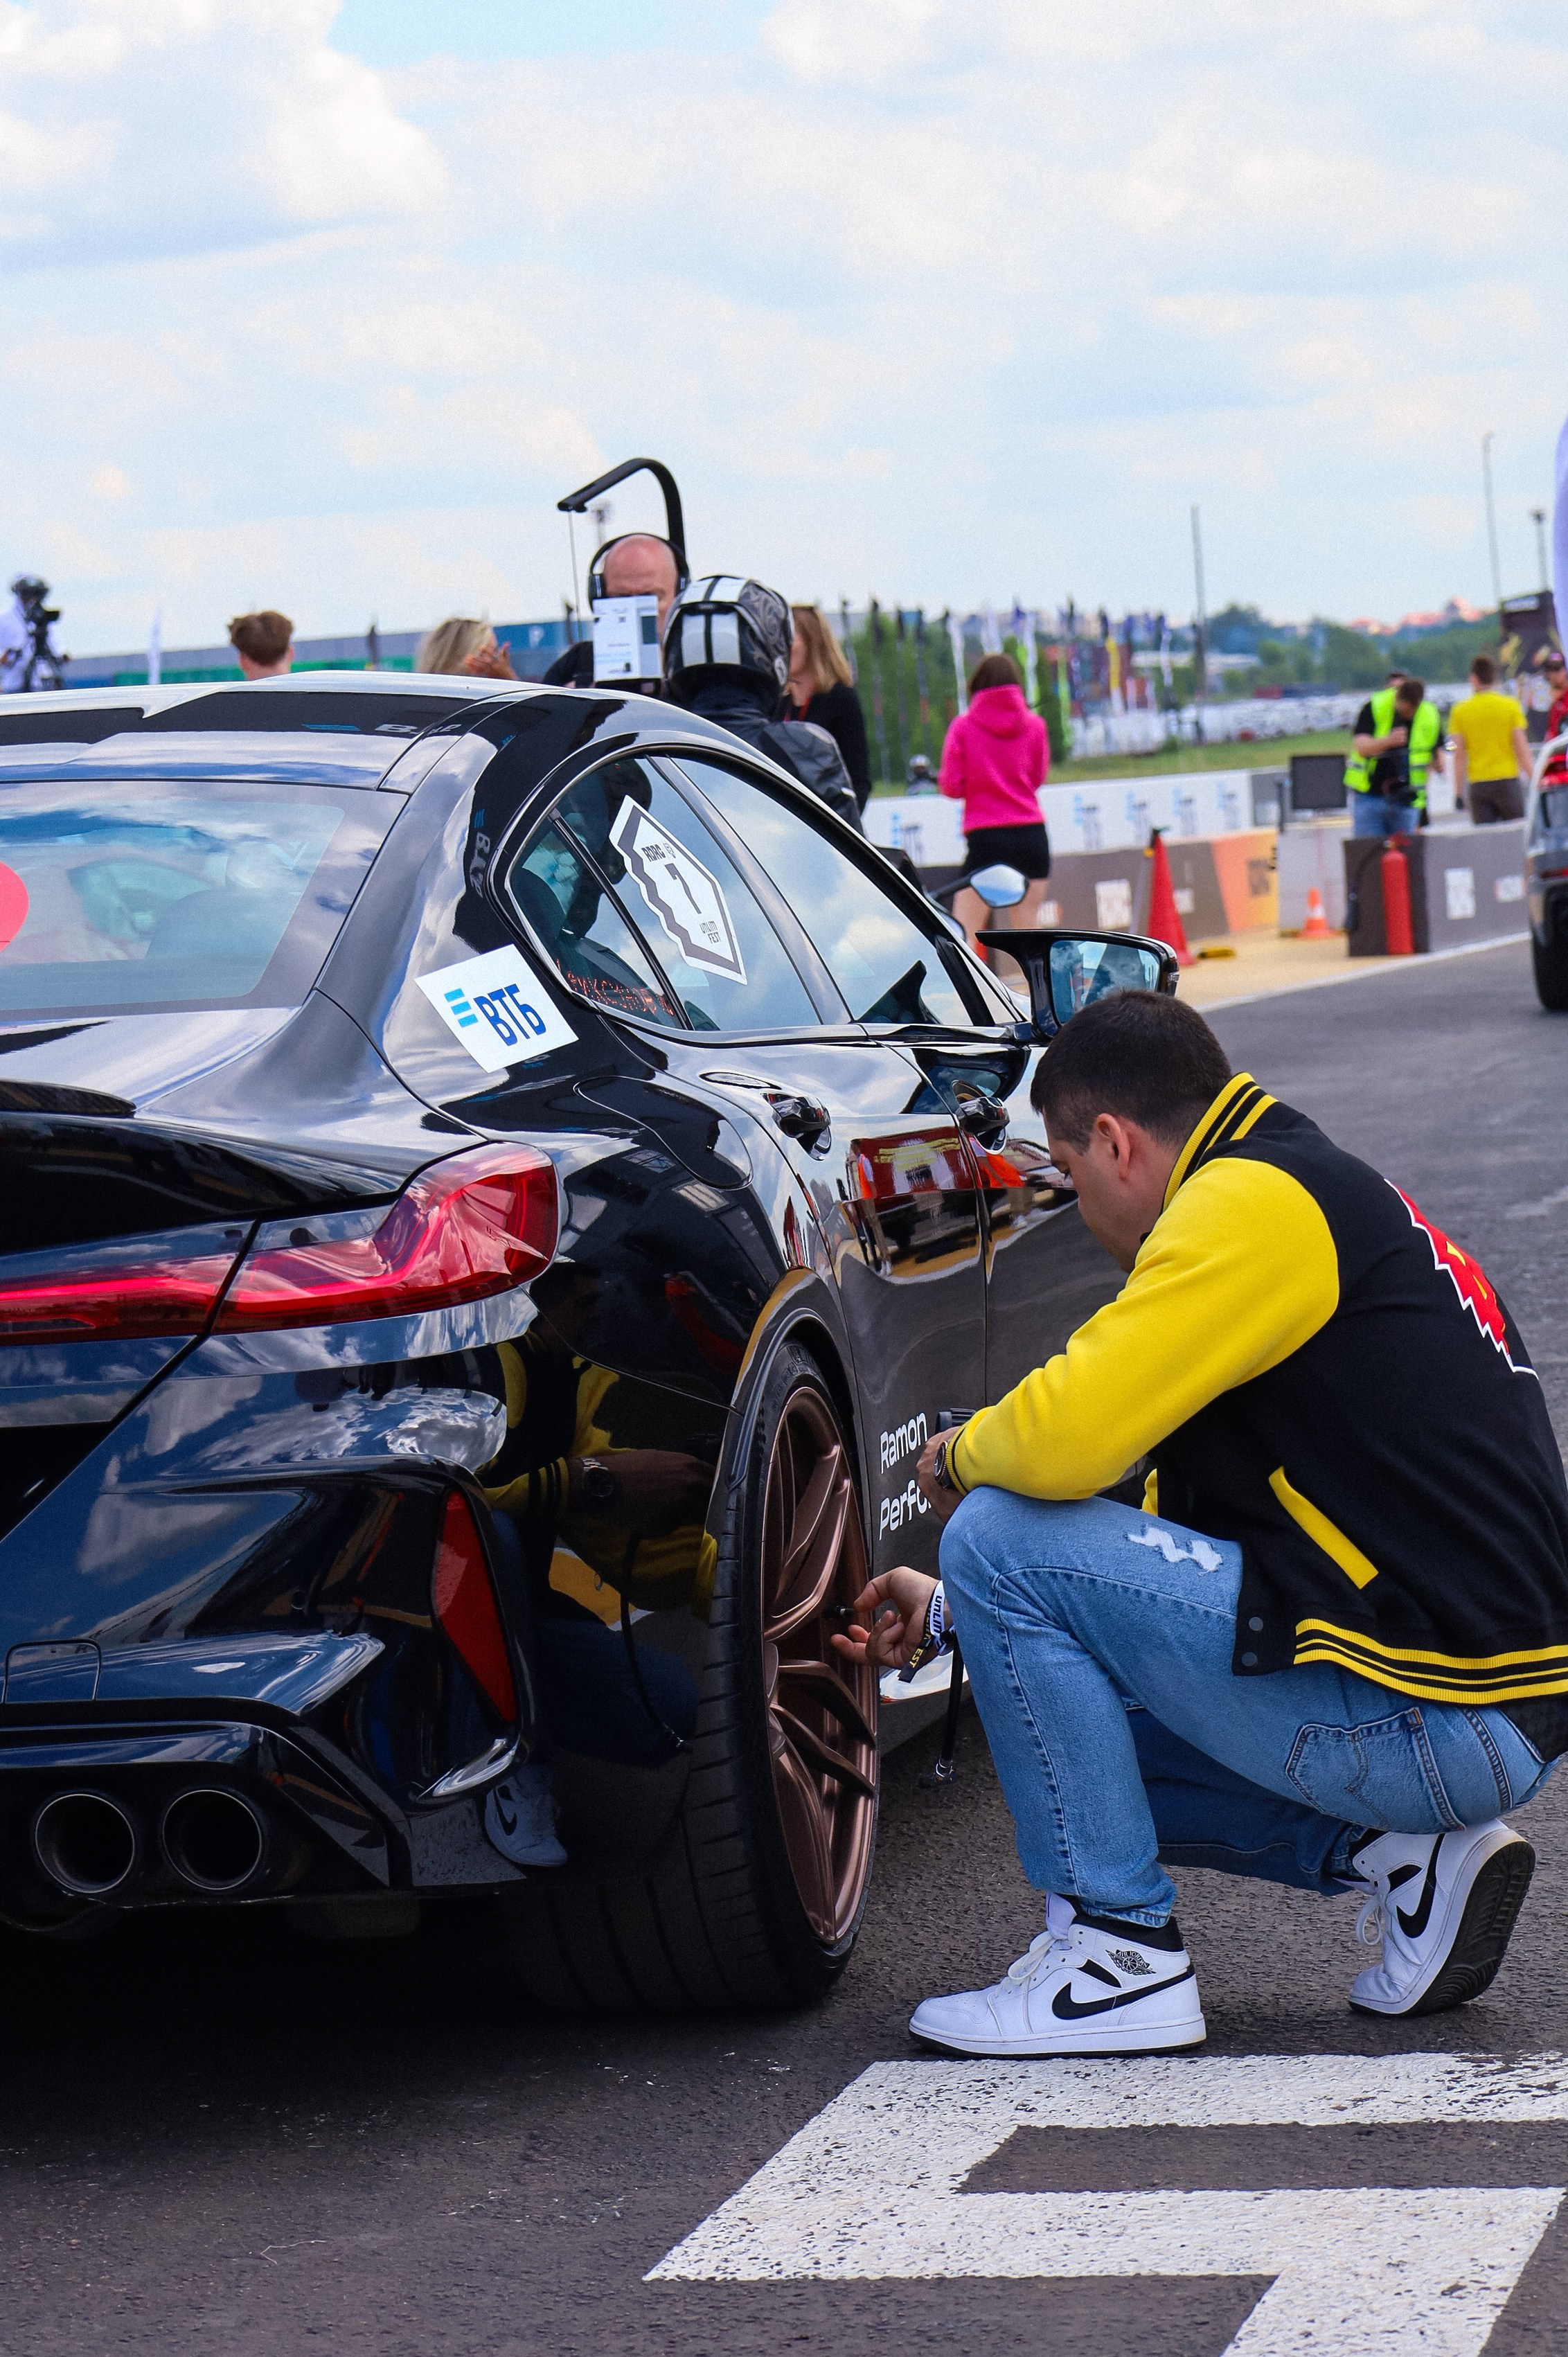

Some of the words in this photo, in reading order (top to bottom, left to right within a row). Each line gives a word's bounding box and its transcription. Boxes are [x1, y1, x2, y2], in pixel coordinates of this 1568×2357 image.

[641, 844, 666, 862] RDRC
[664, 862, 702, 915] 7
[473, 984, 546, 1047] ВТБ
[880, 1412, 928, 1475] Ramon
